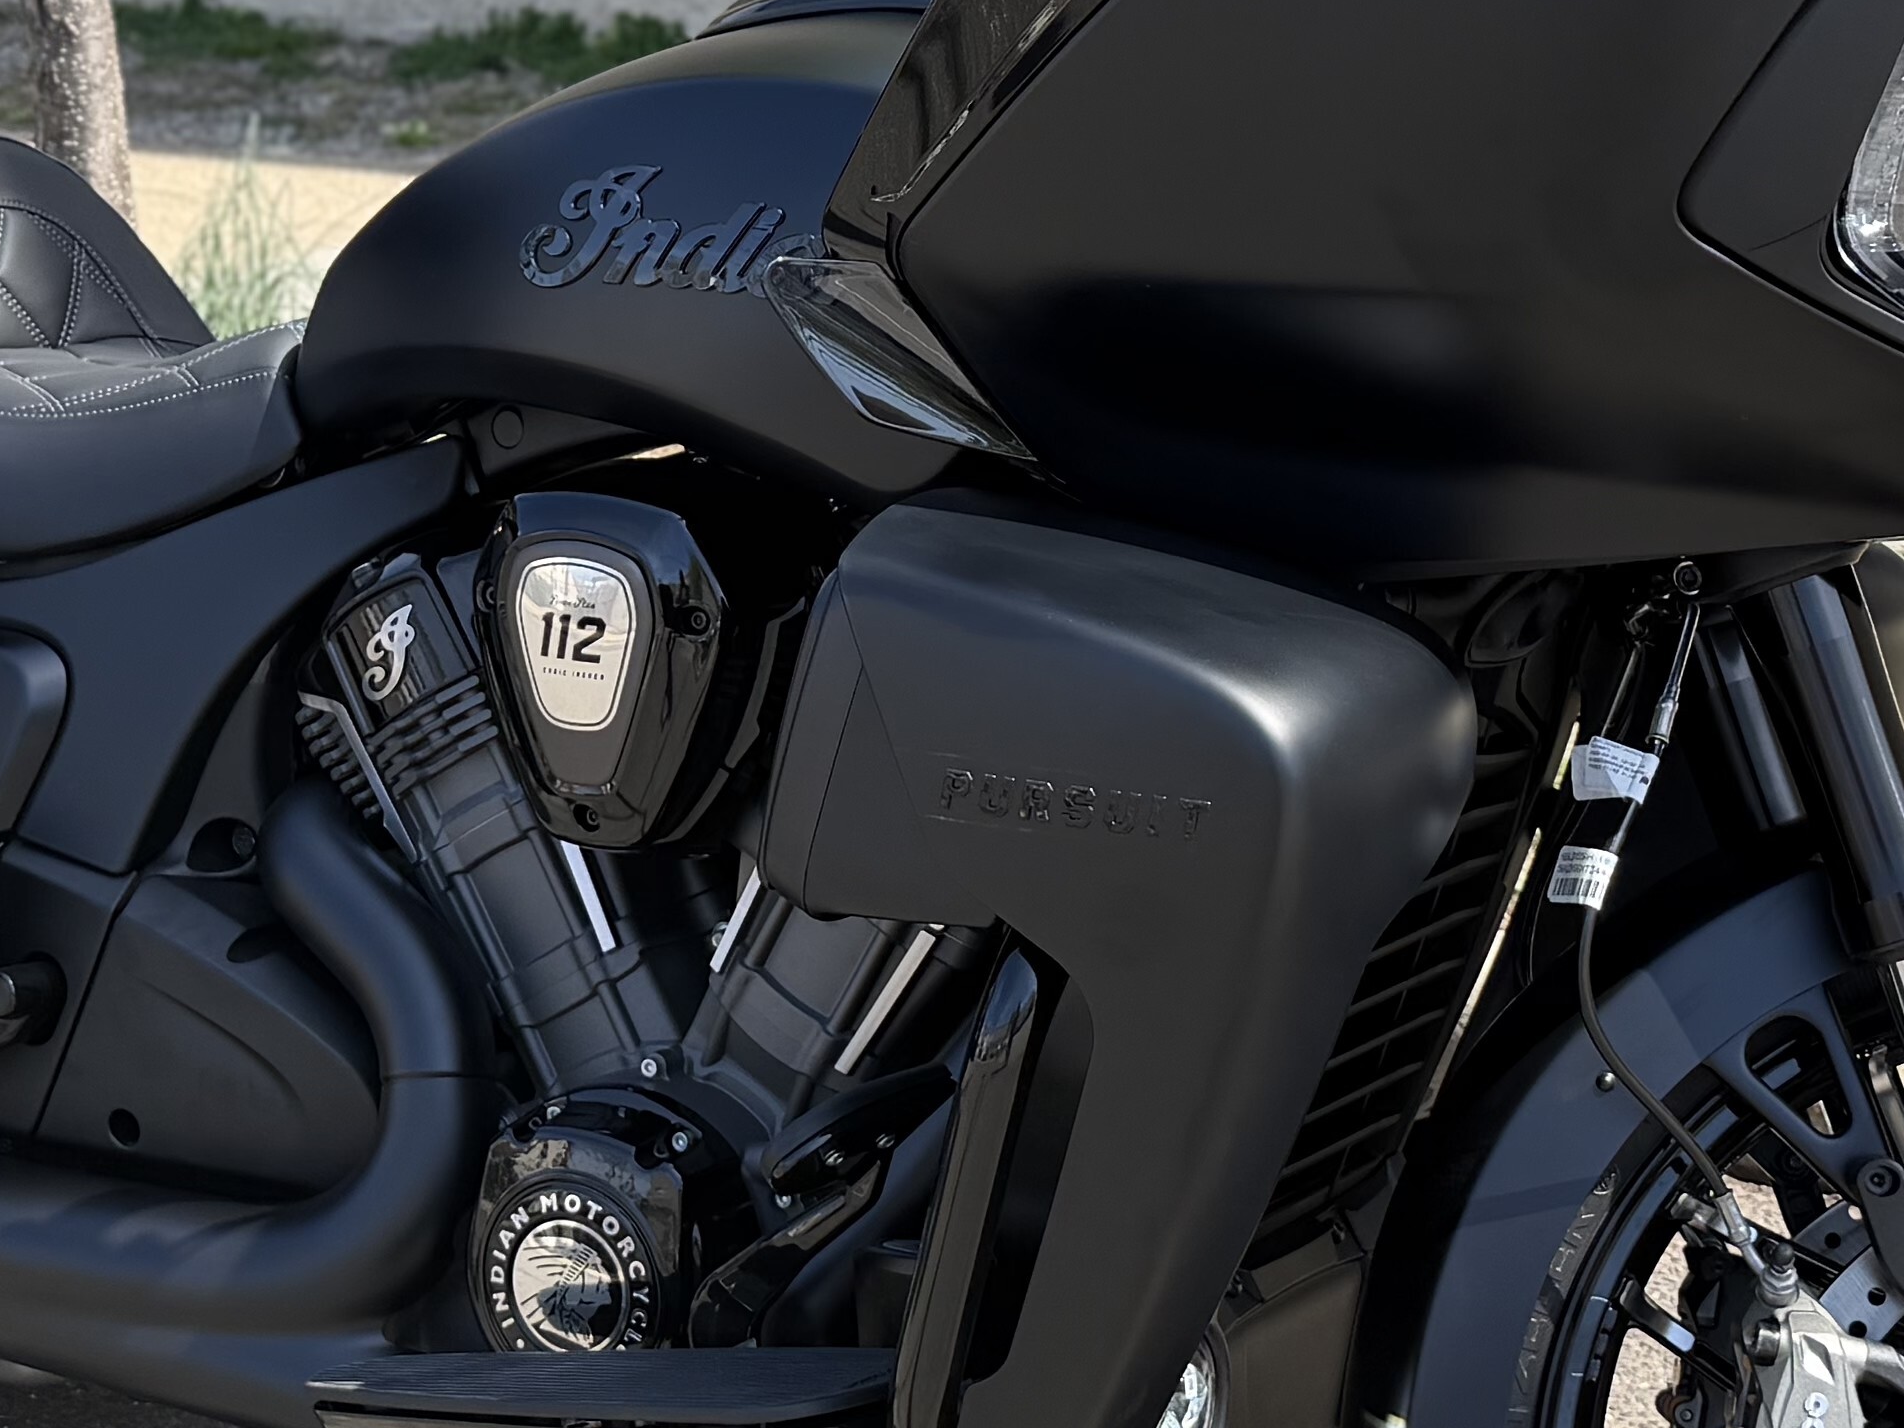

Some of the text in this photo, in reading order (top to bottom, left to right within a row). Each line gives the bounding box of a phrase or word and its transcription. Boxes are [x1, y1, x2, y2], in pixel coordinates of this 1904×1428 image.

[540, 612, 607, 664] 112
[939, 767, 1213, 842] PURSUIT
[490, 1192, 651, 1348] INDIAN MOTORCYCL
